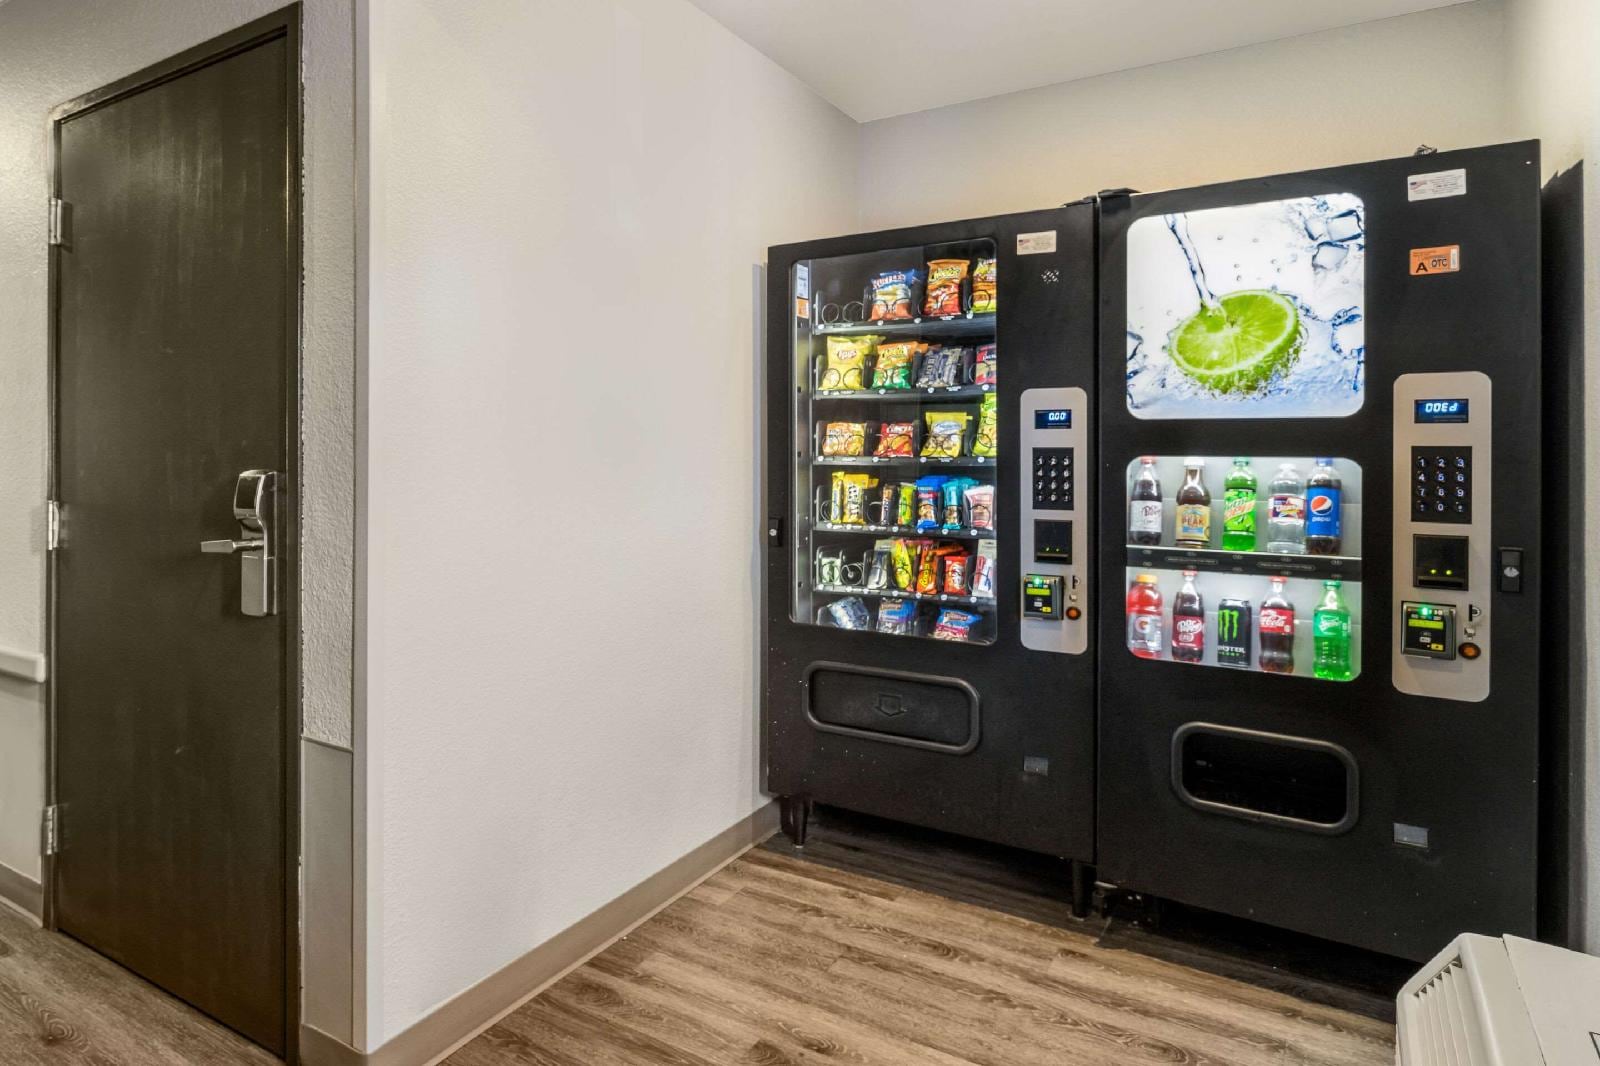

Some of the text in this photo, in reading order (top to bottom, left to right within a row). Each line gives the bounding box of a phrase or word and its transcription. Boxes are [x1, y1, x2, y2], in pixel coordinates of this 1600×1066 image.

[1416, 262, 1428, 273] A
[1420, 459, 1464, 468] 1 2 3
[1458, 474, 1464, 482] 6
[1037, 481, 1043, 490] 7
[1419, 489, 1464, 497] 7 8 9
[1437, 503, 1444, 511] 0
